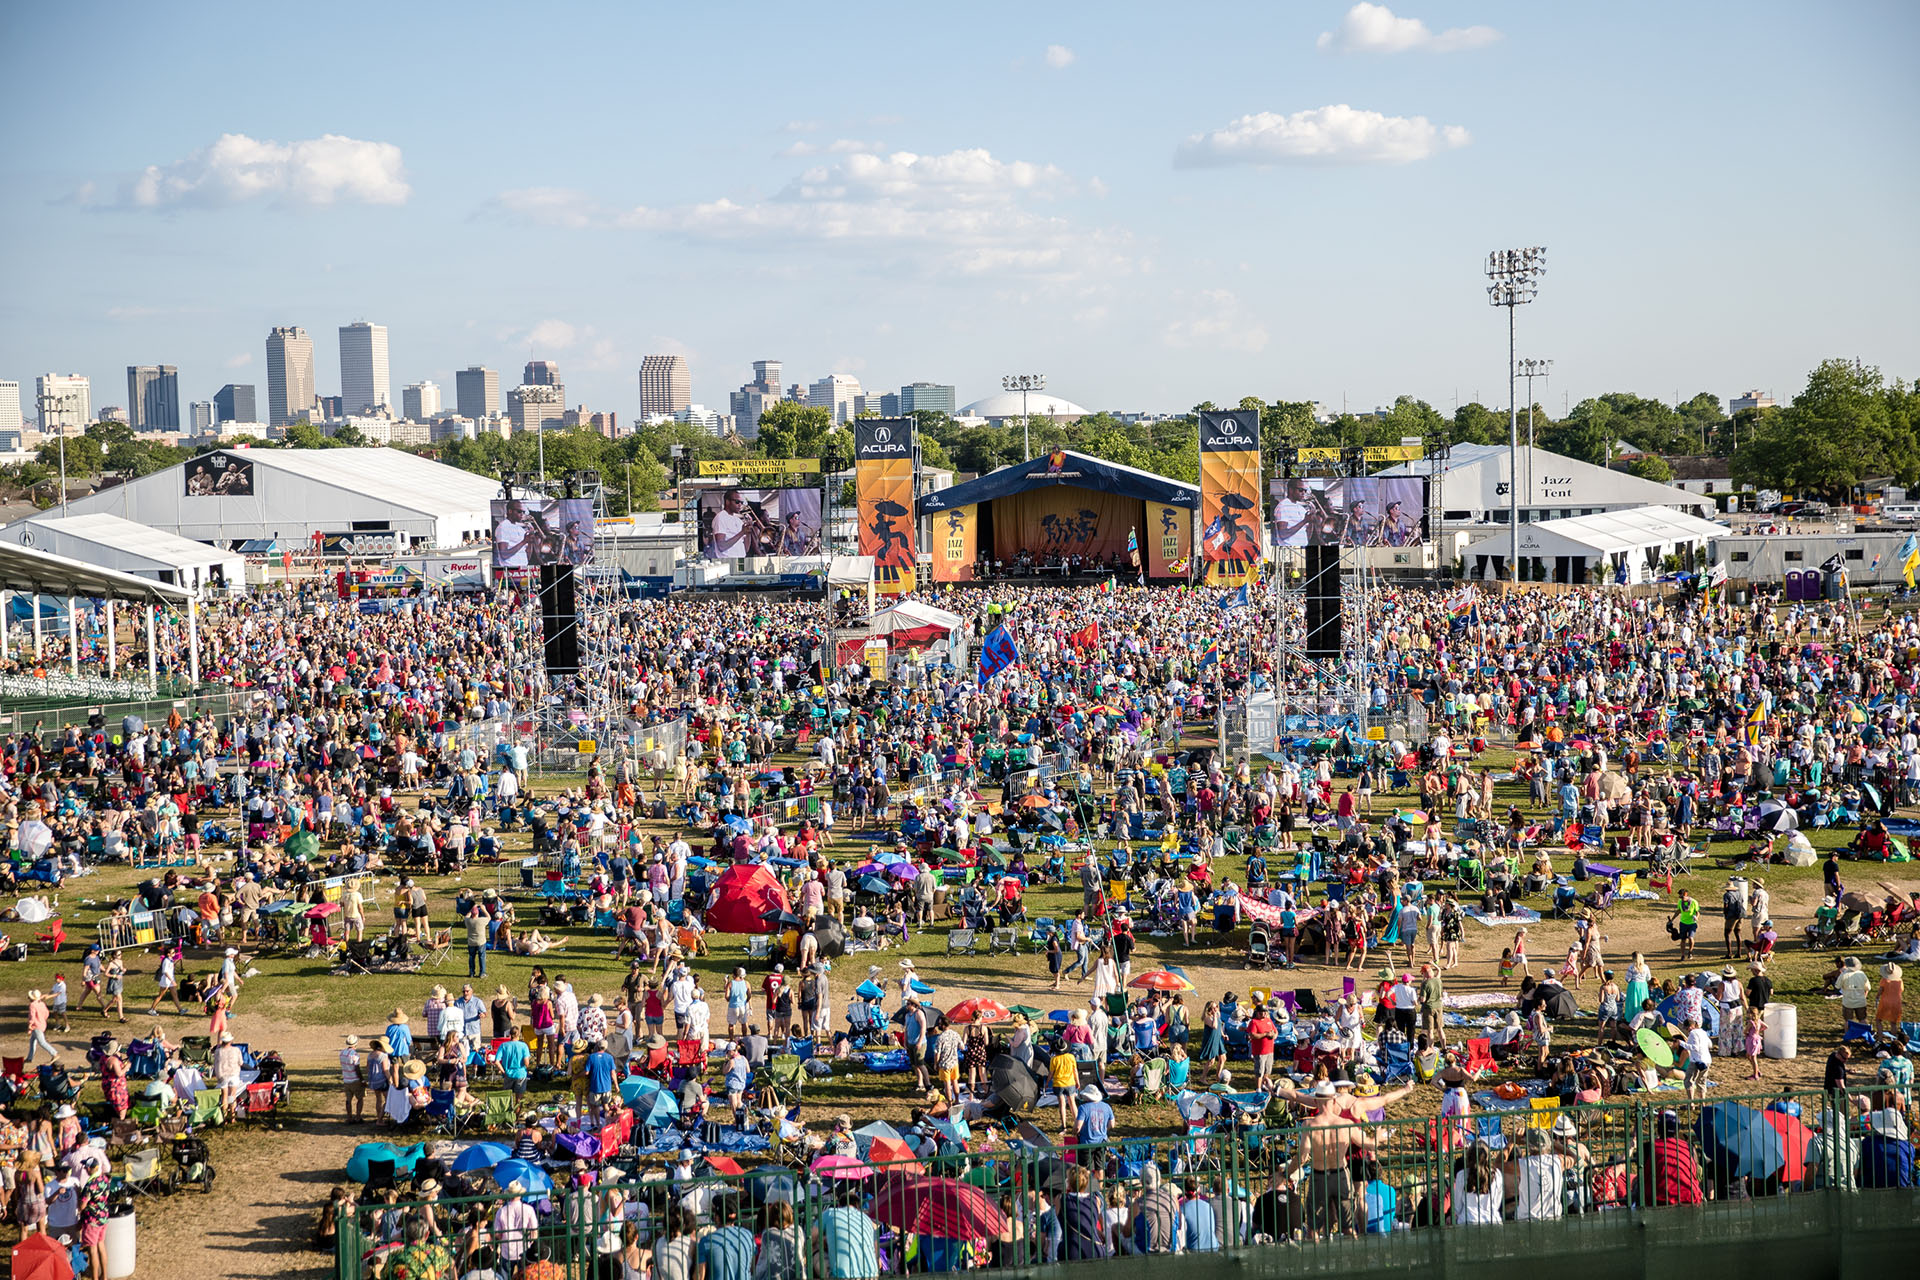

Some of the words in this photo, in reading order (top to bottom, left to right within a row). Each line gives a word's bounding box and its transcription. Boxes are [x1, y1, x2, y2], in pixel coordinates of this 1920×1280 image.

[1206, 436, 1253, 445] ACURA
[861, 444, 907, 453] ACURA
[1540, 476, 1572, 485] Jazz
[1541, 489, 1572, 497] Tent
[948, 539, 963, 548] JAZZ
[1163, 537, 1177, 547] JAZZ
[947, 550, 963, 559] FEST
[1163, 548, 1177, 557] FEST
[450, 563, 477, 572] Ryder
